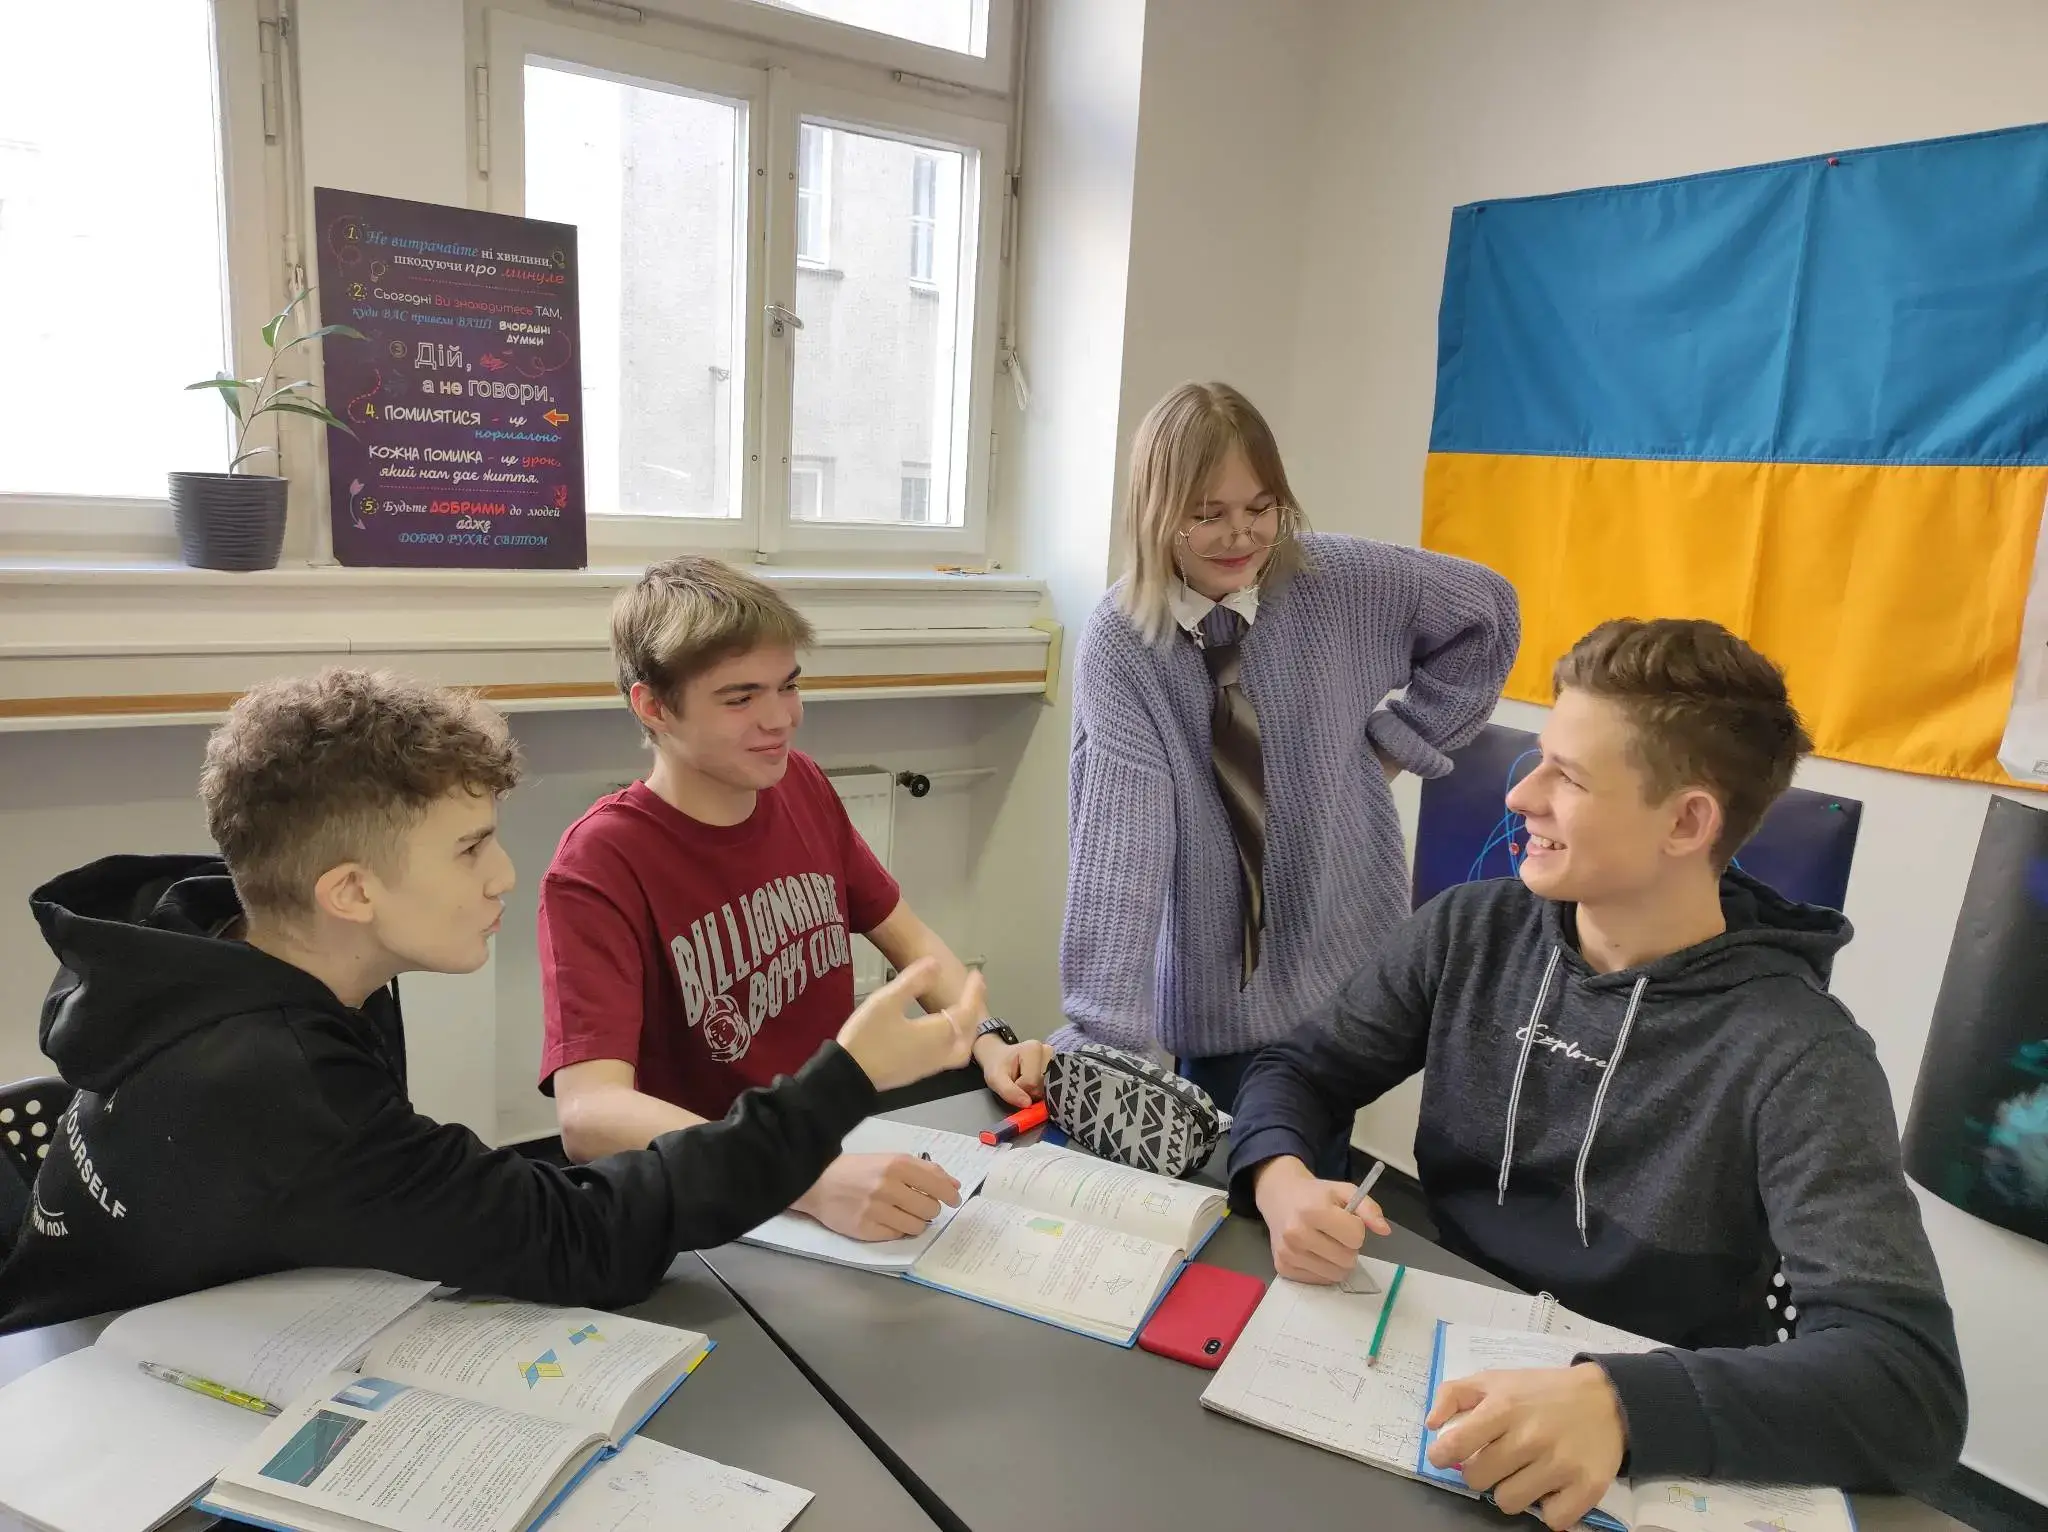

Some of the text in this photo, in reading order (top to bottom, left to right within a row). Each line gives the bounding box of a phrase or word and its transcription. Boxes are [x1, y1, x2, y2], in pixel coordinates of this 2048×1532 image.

[365, 230, 388, 246] Не
[391, 236, 480, 258] витрачайте
[481, 249, 494, 260] ні
[393, 255, 565, 286] шкодуючи про минуле
[373, 288, 432, 306] Сьогодні
[435, 294, 451, 307] Ви
[454, 299, 534, 317] знаходитесь
[535, 305, 563, 320] ТАМ,
[351, 306, 379, 321] куди
[411, 313, 454, 327] привели
[506, 333, 544, 346] ДУМКИ
[414, 342, 472, 372] Дій,
[422, 379, 555, 405] а не говори.
[384, 405, 481, 426] ПОМИЛЯТИСЯ
[509, 416, 528, 428] це
[475, 430, 561, 443] нормально
[368, 445, 420, 462] КОЖНА
[423, 448, 483, 464] ПОМИЛКА
[501, 455, 519, 467] це
[379, 464, 540, 485] який нам дає життя.
[383, 500, 428, 516] Будьте
[429, 500, 507, 516] ДОБРИМИ
[509, 504, 522, 516] до
[527, 506, 561, 518] людей
[455, 516, 493, 534] адже
[398, 532, 444, 544] ДОБРО
[670, 872, 844, 1028] BILLIONAIRE
[748, 938, 808, 1037] BOYS
[66, 1094, 127, 1219] YOURSELF
[47, 1220, 69, 1237] YOU
